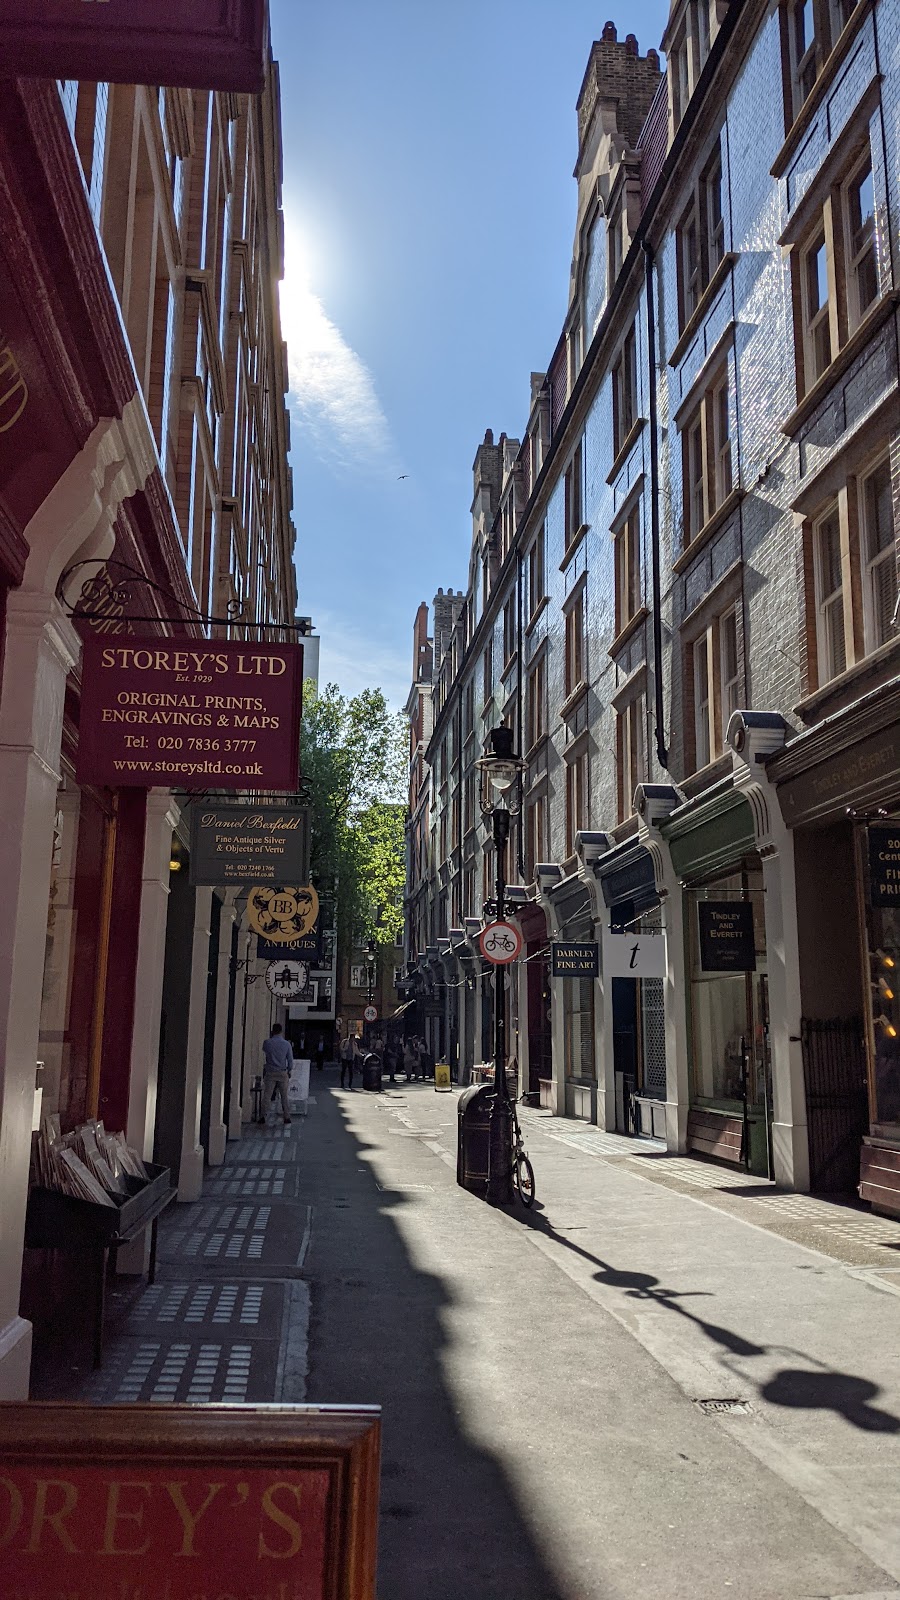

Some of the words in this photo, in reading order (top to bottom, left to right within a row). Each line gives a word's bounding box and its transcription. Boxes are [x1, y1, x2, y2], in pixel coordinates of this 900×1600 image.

[101, 649, 229, 674] STOREY'S
[236, 655, 287, 676] LTD
[175, 674, 190, 682] Est.
[192, 675, 213, 684] 1929
[117, 691, 201, 708] ORIGINAL
[204, 695, 267, 712] PRINTS,
[101, 709, 212, 727] ENGRAVINGS
[216, 714, 230, 727] &
[234, 715, 280, 729] MAPS
[124, 735, 149, 749] Tel:
[157, 736, 183, 750] 020
[187, 737, 220, 751] 7836
[224, 738, 257, 753] 3777
[113, 759, 264, 776] www.storeysltd.co.uk
[200, 813, 247, 829] Daniel
[246, 814, 301, 833] Bexfield
[215, 834, 232, 843] Fine
[233, 836, 263, 846] Antique
[264, 836, 287, 845] Silver
[216, 844, 223, 852] &
[225, 845, 253, 854] Objects
[255, 845, 264, 853] of
[264, 845, 284, 853] Vertu
[273, 899, 293, 914] BB
[264, 940, 316, 951] ANTIQUES
[556, 949, 595, 958] DARNLEY
[556, 961, 577, 969] FINE
[578, 961, 595, 969] ART
[498, 1019, 504, 1027] 2
